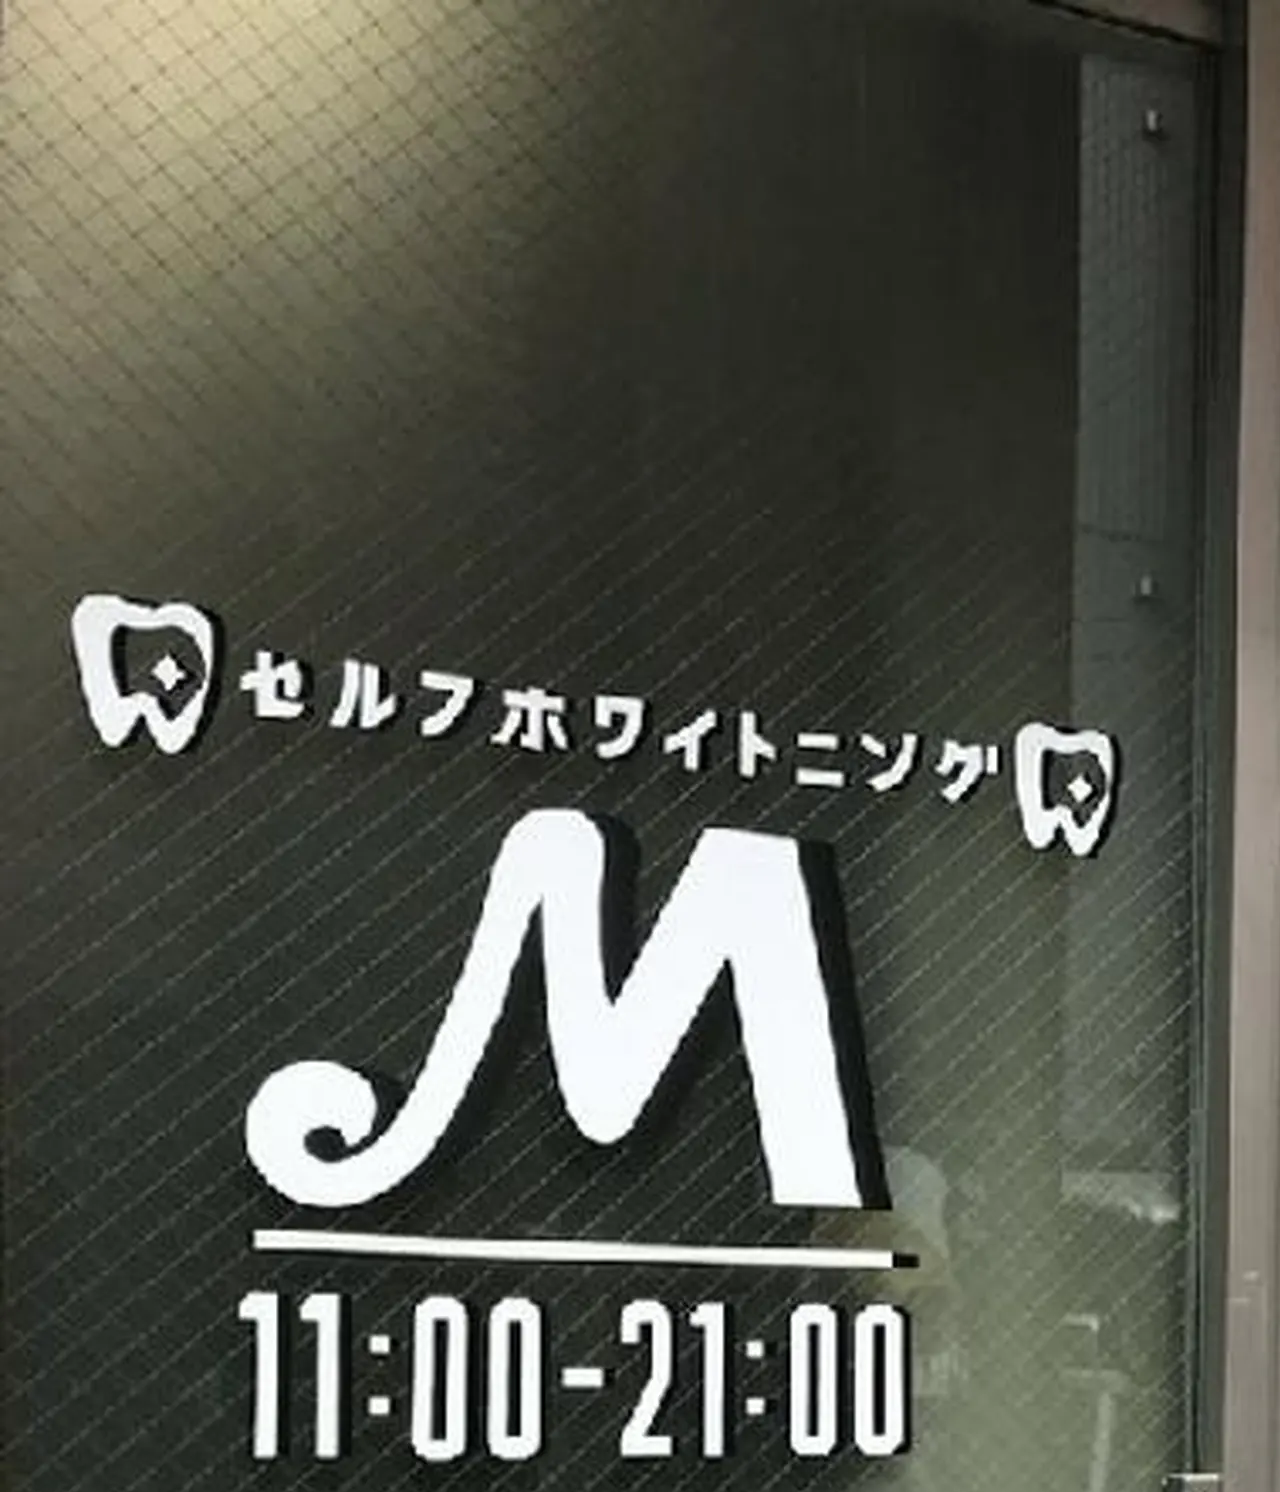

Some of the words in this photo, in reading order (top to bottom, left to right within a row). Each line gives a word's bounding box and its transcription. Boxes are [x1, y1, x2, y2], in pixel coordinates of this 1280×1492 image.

[242, 651, 1001, 808] セルフホワイトニング
[245, 808, 870, 1210] M
[238, 1293, 910, 1464] 11:00-21:00
